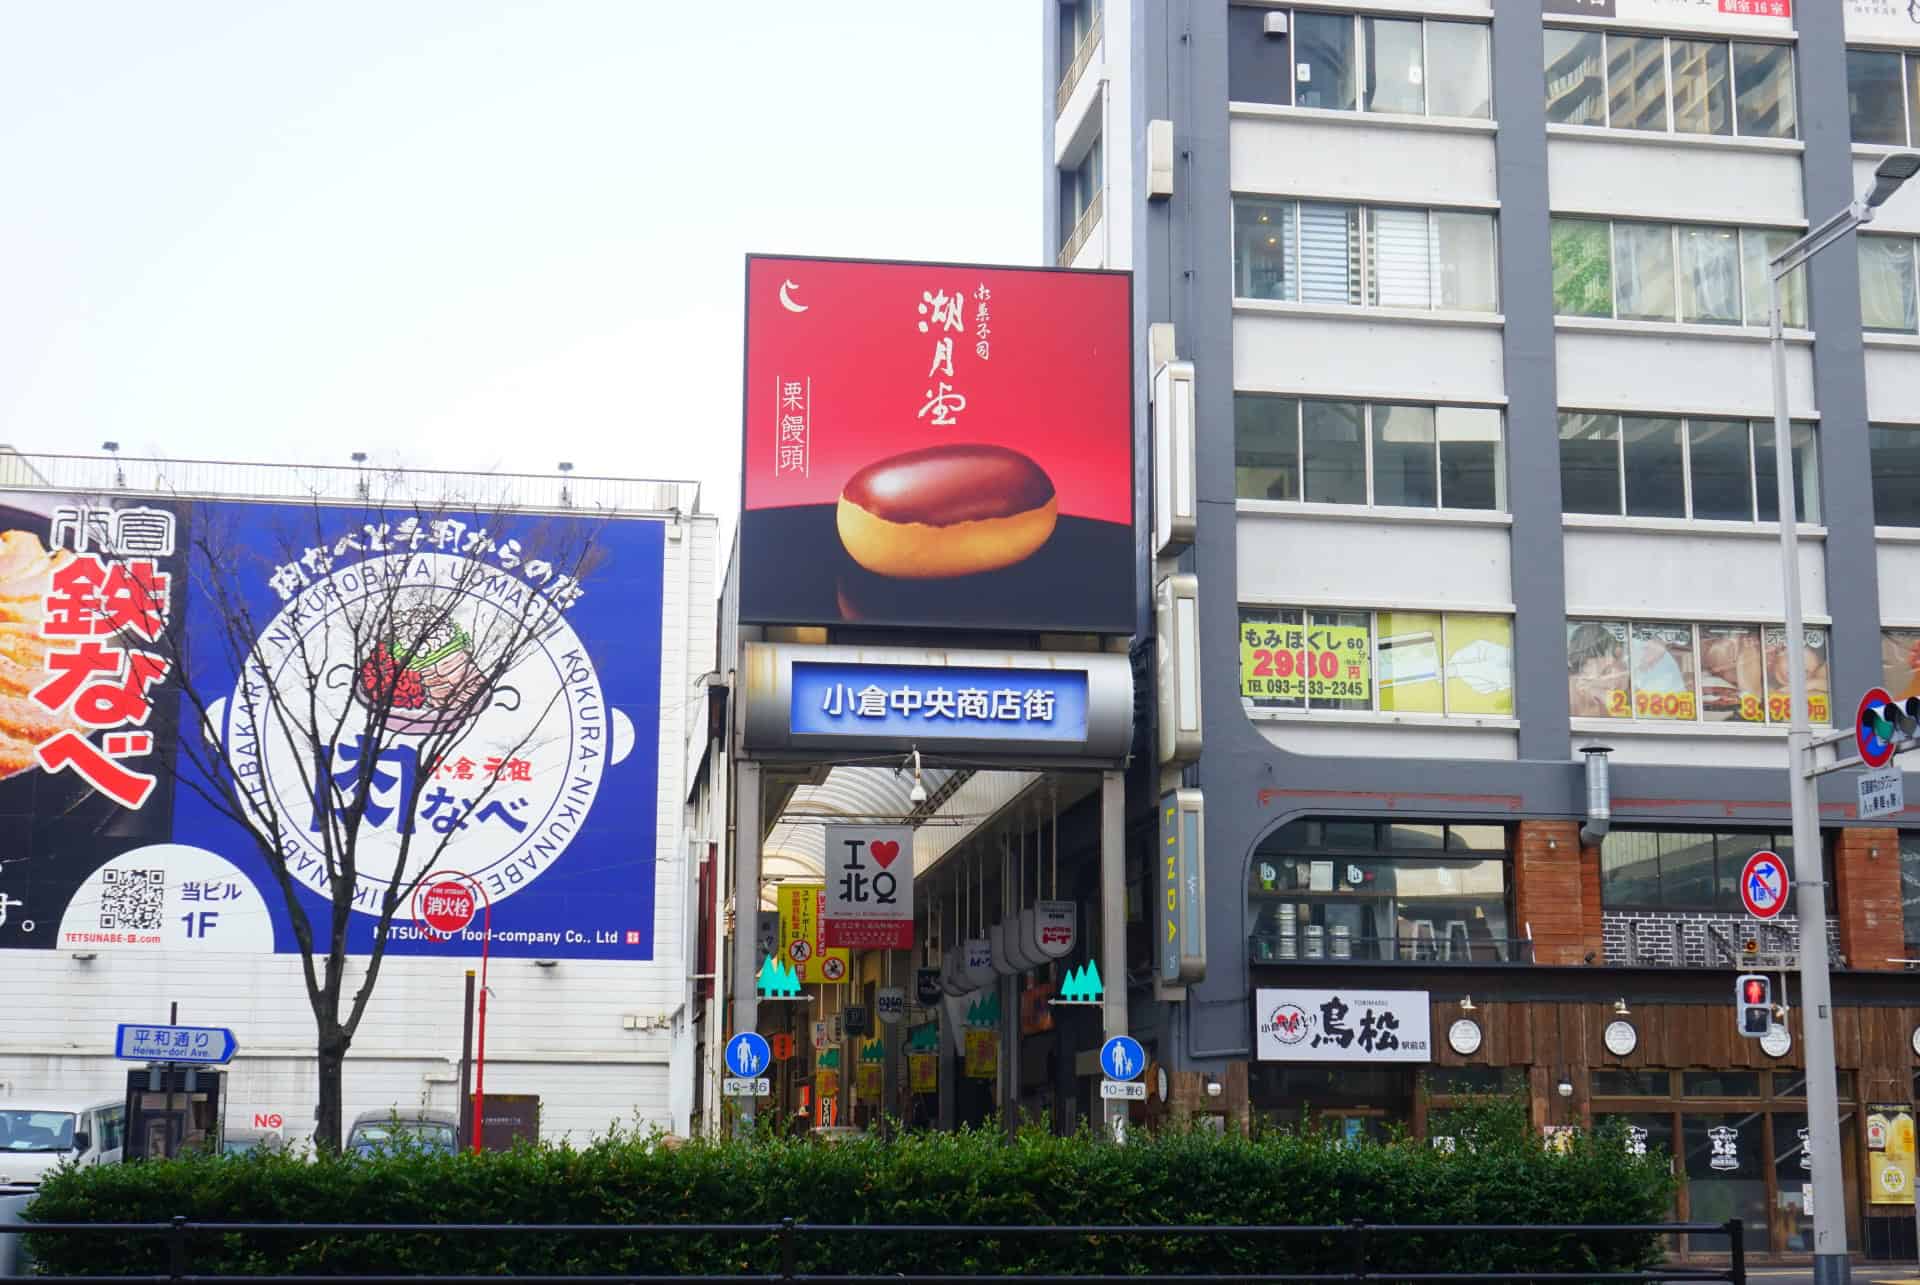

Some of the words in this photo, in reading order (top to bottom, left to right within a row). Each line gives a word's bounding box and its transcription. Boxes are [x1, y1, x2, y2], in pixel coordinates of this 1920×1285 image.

[917, 288, 967, 425] 湖月堂
[781, 381, 806, 473] 栗饅頭
[1252, 649, 1339, 679] 2980
[29, 552, 172, 810] 鉄なべ
[1267, 679, 1363, 696] 093-533-2345
[823, 683, 1056, 721] 小倉中央商店街
[181, 881, 242, 901] 当ビル
[426, 896, 470, 918] 消火栓
[182, 911, 219, 938] 1F
[596, 931, 618, 944] Ltd
[134, 1029, 209, 1048] 平和通り
